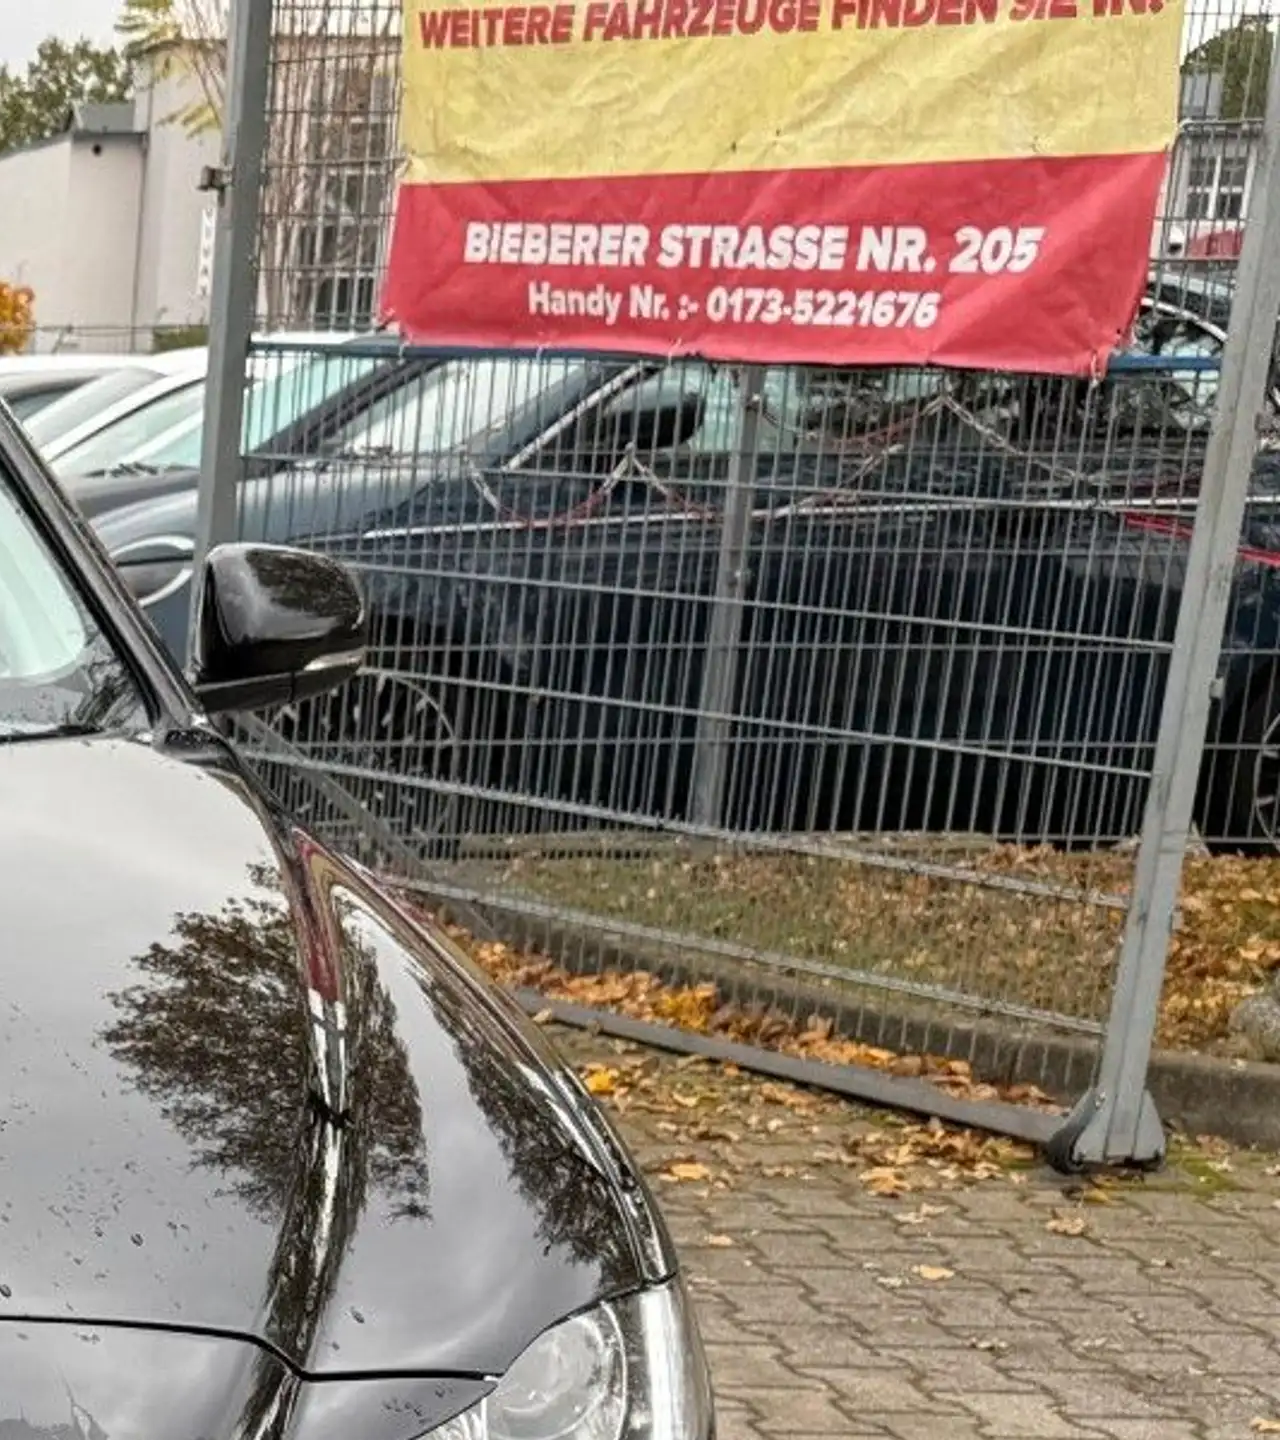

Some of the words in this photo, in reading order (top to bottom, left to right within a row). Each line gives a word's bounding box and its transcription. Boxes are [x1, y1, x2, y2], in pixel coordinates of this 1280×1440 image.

[419, 5, 575, 48] WEITERE
[583, 0, 818, 41] FAHRZEUGE
[830, 0, 998, 30] FINDEN
[464, 221, 650, 266] BIEBERER
[656, 224, 849, 270] STRASSE
[856, 225, 937, 273] NR.
[948, 226, 1045, 274] 205
[528, 280, 622, 325] Handy
[629, 284, 669, 320] Nr.
[706, 286, 940, 328] 0173-5221676
